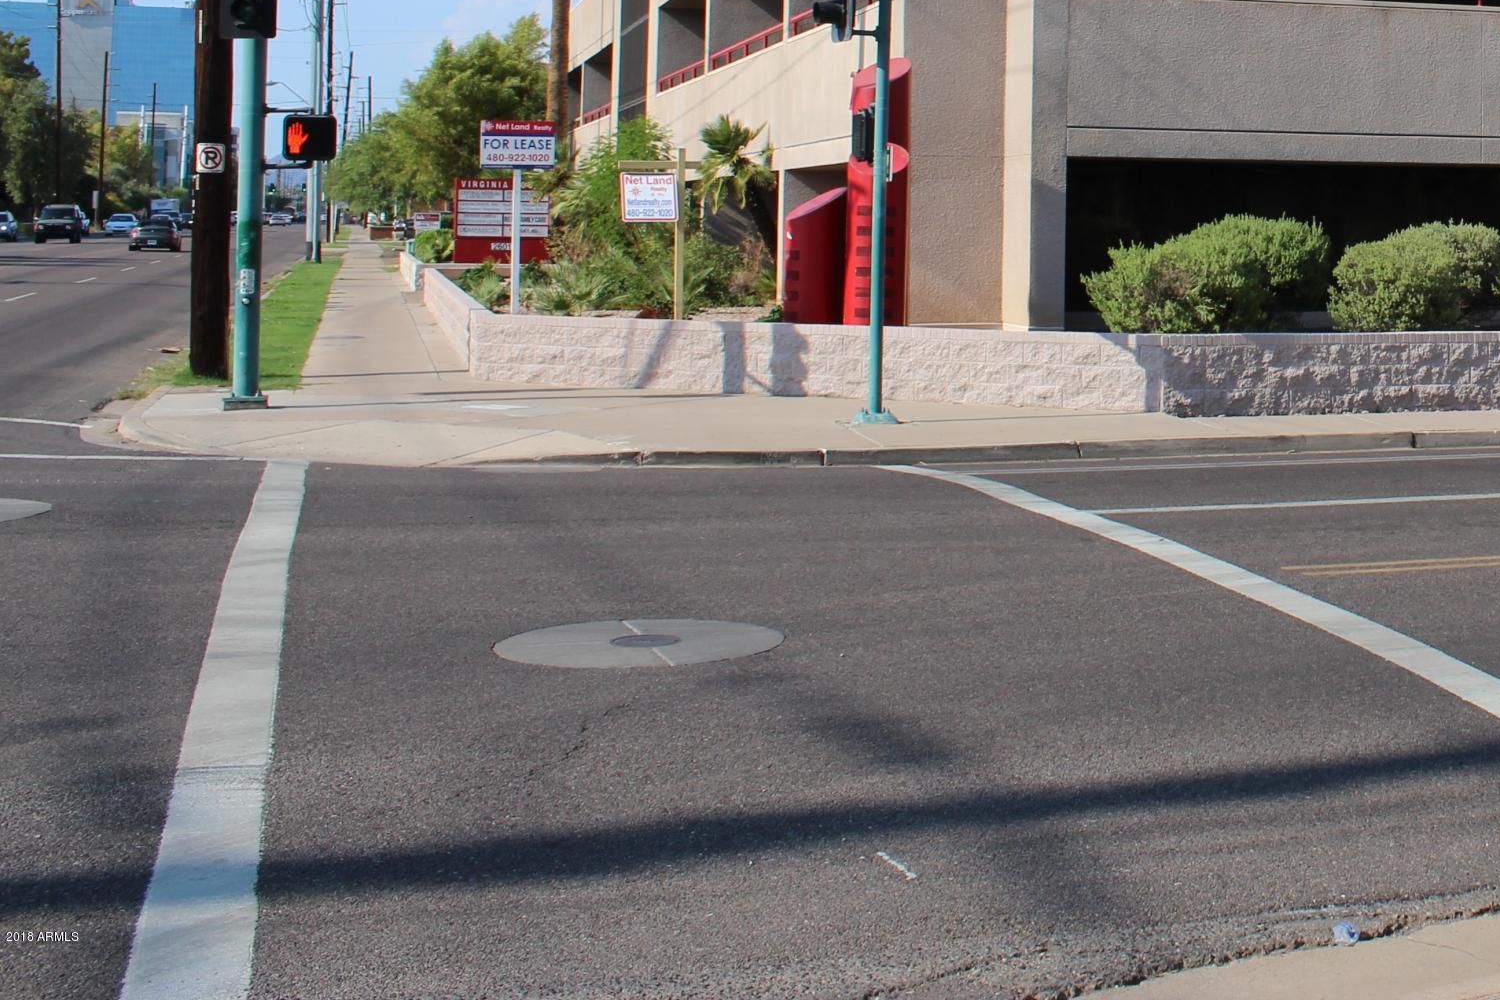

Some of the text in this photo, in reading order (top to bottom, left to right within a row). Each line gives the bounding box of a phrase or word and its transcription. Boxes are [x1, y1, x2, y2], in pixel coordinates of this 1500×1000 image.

[483, 139, 552, 150] FOR LEASE
[487, 154, 550, 162] 480-922-1020
[461, 180, 509, 188] VIRGINIA
[625, 175, 672, 185] Net Land
[627, 208, 673, 217] 480-922-1020
